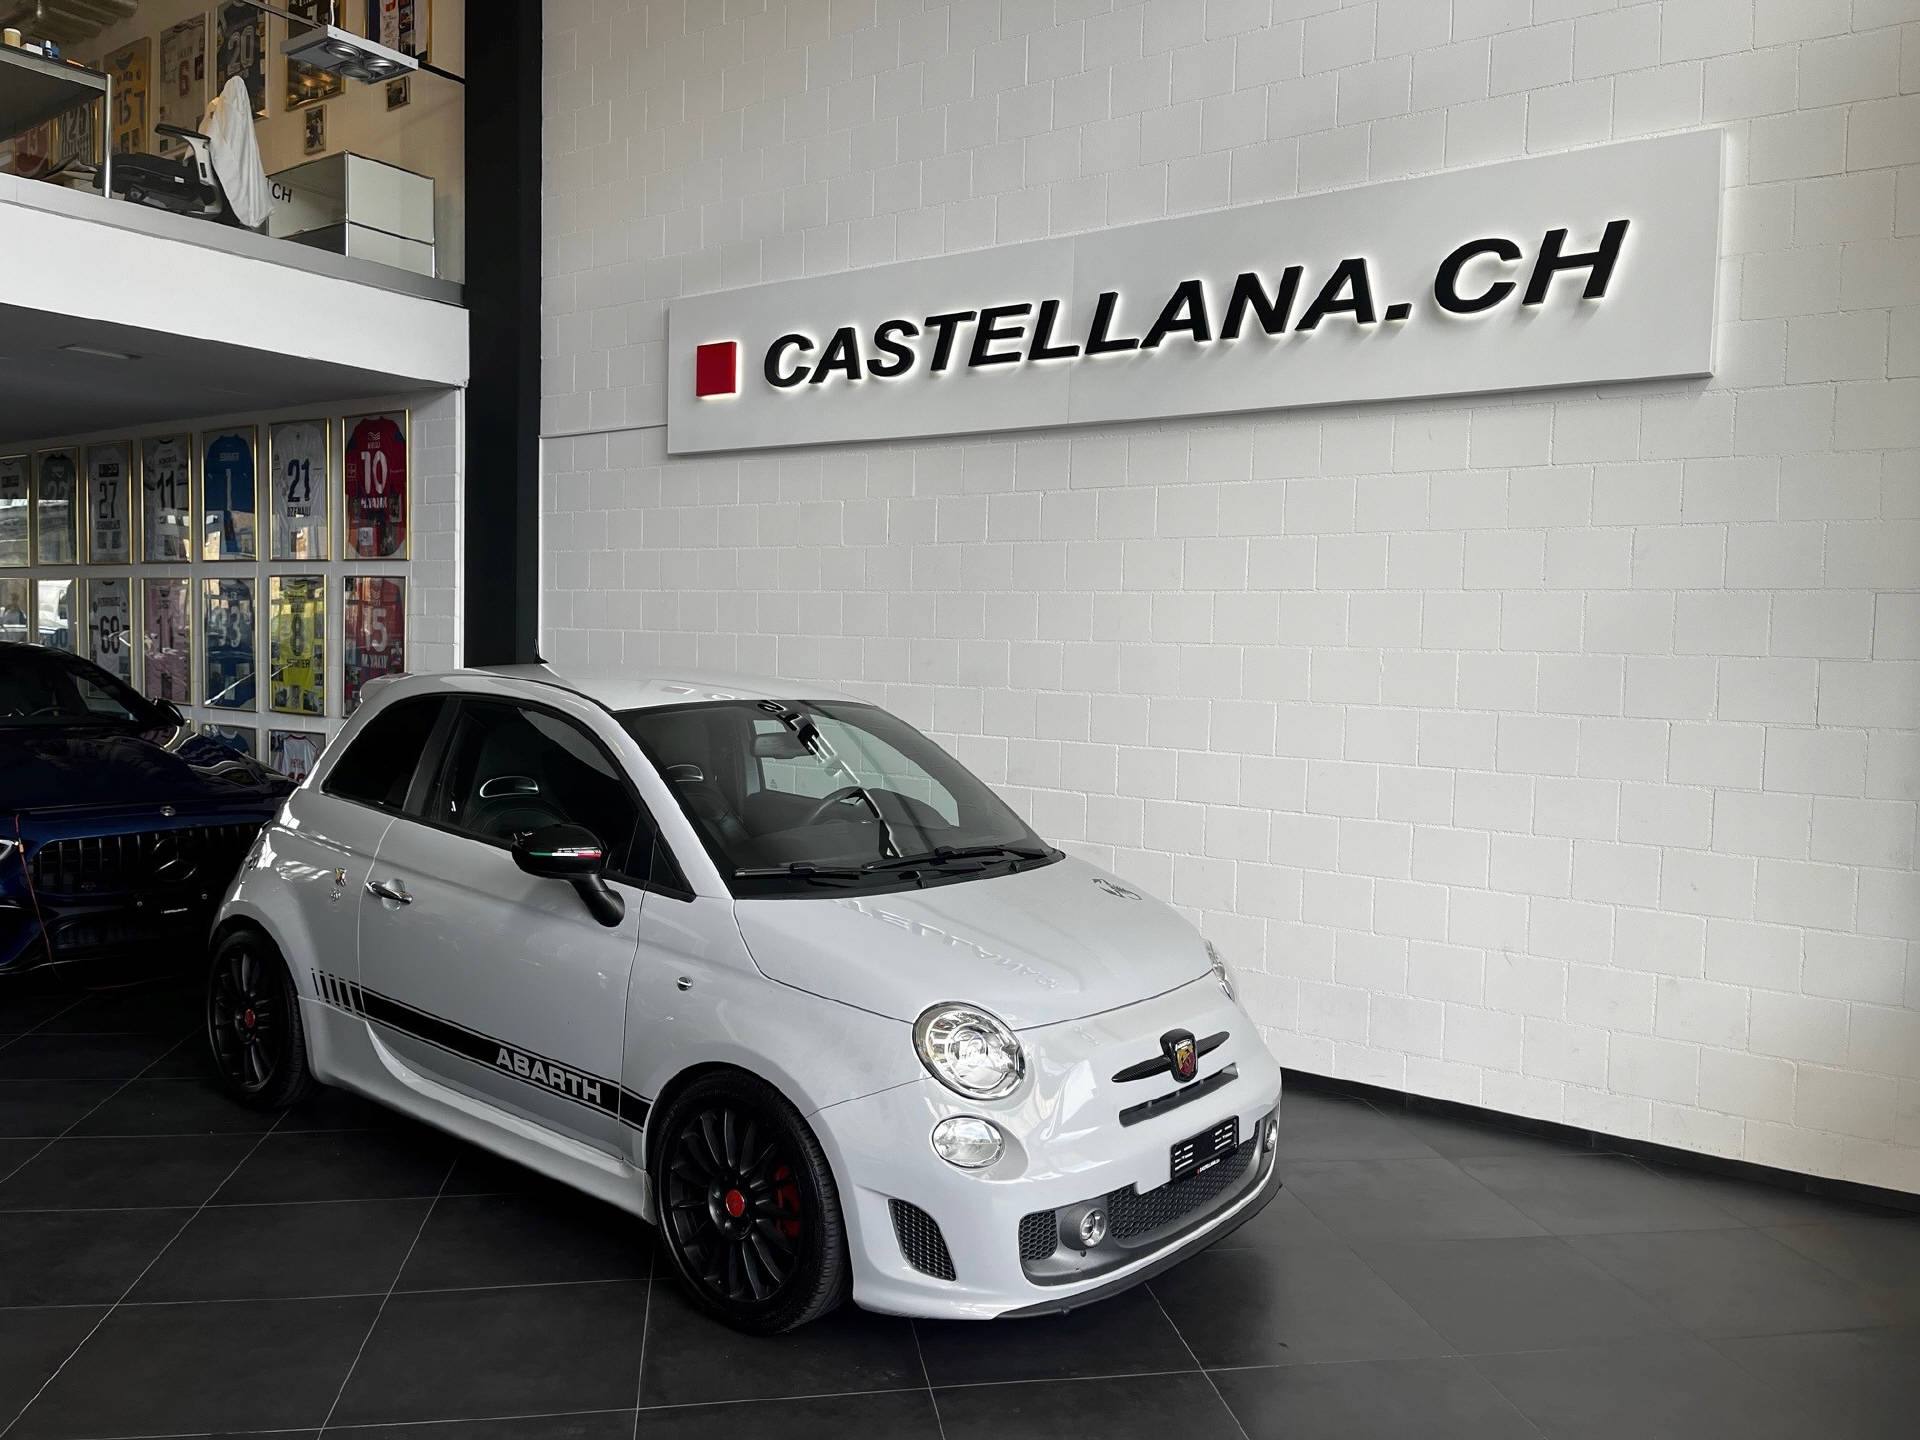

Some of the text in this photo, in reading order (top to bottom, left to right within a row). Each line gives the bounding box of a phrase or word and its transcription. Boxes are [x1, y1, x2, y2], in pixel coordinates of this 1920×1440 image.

[227, 24, 255, 76] 20
[157, 470, 176, 512] 11
[287, 458, 311, 503] 21
[360, 449, 388, 495] 10
[99, 480, 118, 519] 27
[362, 607, 388, 654] 15
[496, 1047, 601, 1104] ABARTH
